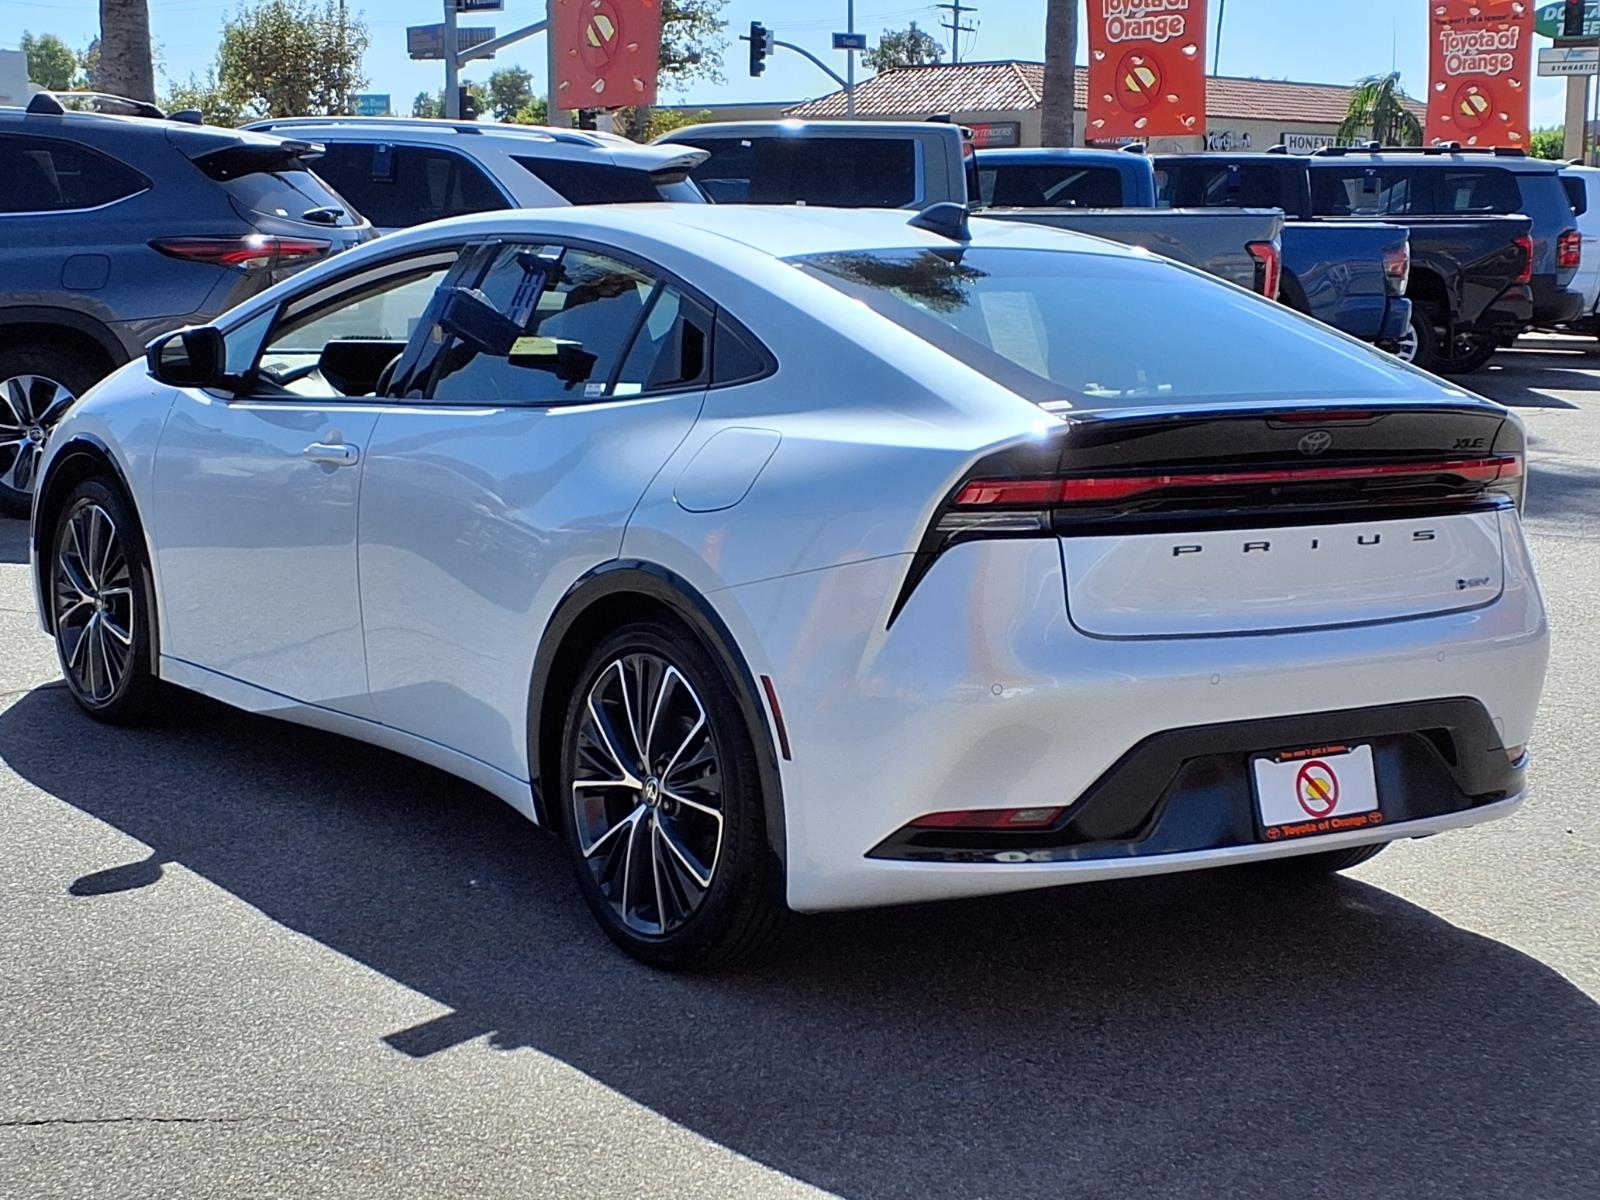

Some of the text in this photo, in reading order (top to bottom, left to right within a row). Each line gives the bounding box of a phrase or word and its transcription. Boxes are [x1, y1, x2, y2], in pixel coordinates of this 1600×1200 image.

[1106, 15, 1185, 42] Orange
[1556, 21, 1600, 36] TEE
[1440, 27, 1519, 55] Toyota of
[1445, 53, 1514, 76] Orange
[1453, 438, 1484, 449] XLE
[1172, 529, 1436, 557] PRIUS
[1281, 815, 1367, 836] Toyota of Orange
